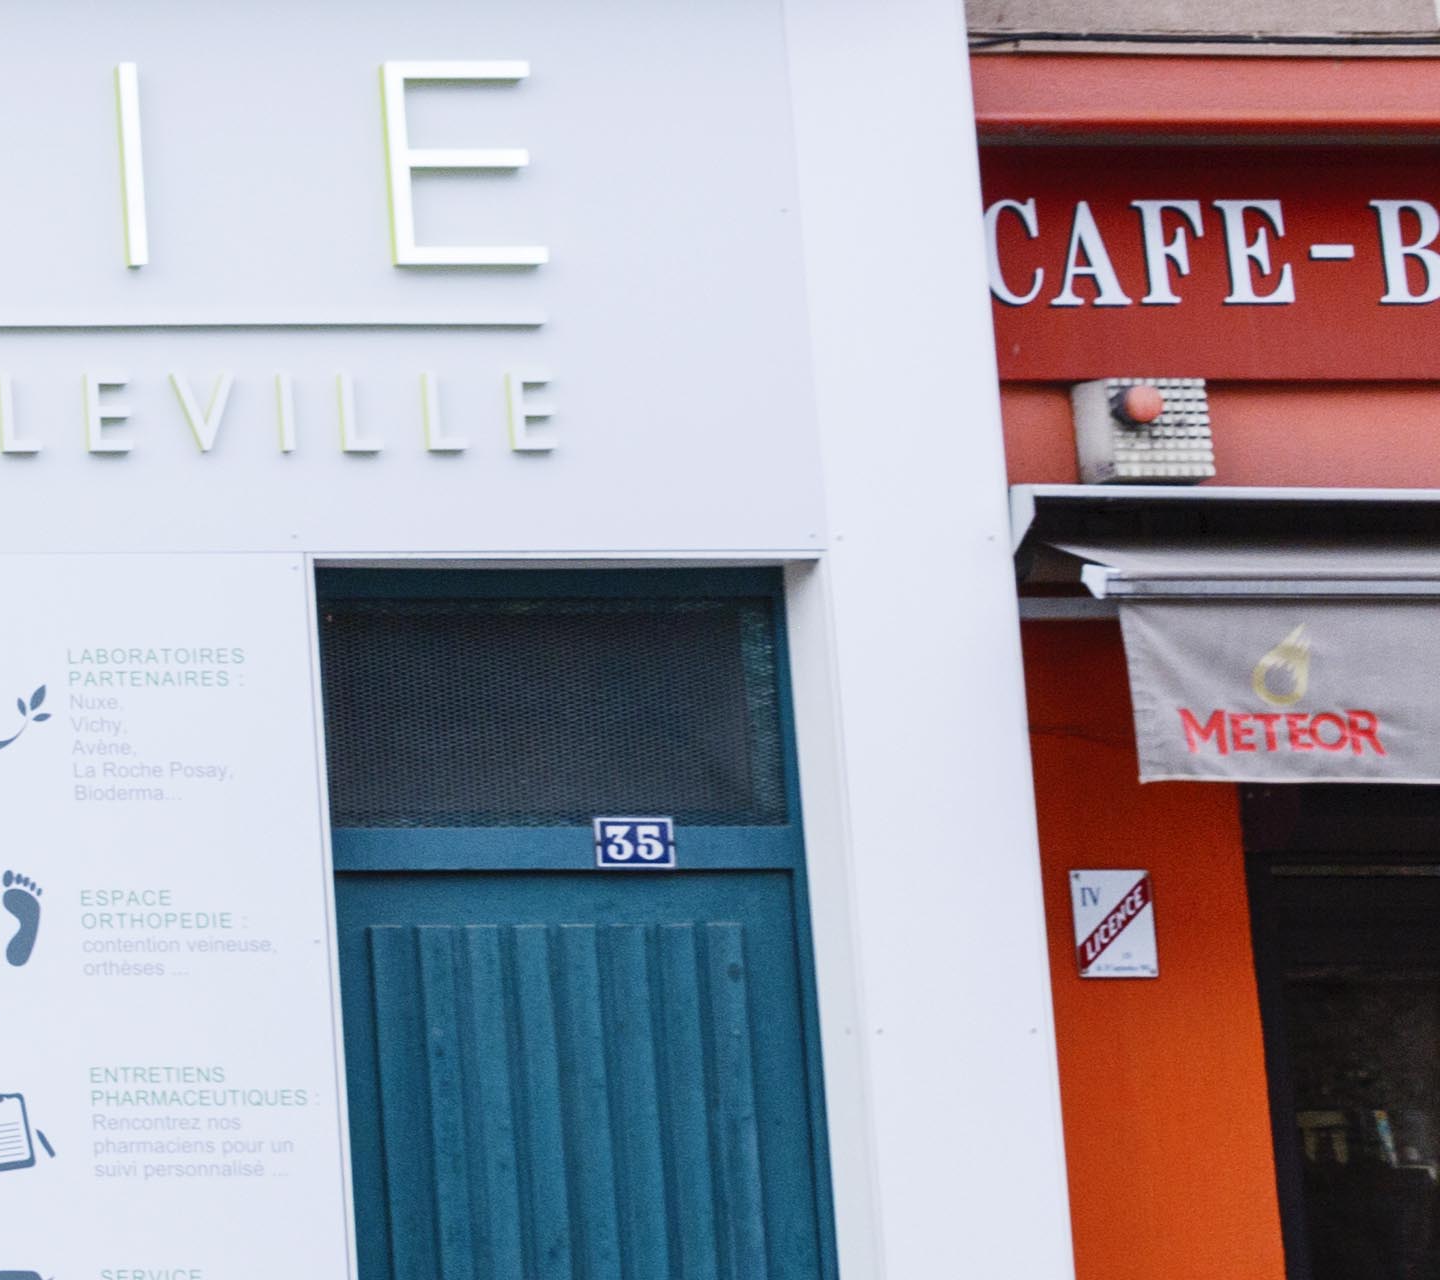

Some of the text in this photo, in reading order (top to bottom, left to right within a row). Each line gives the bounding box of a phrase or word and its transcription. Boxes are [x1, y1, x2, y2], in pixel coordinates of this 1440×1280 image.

[66, 647, 246, 665] LABORATOIRES
[68, 670, 230, 688] PARTENAIRES
[1178, 706, 1388, 758] METEOR
[605, 825, 664, 860] 35
[79, 889, 172, 907] ESPACE
[1081, 886, 1101, 908] IV
[80, 911, 233, 930] ORTHOPEDIE
[1084, 884, 1144, 961] LICENCE
[89, 1066, 226, 1084] ENTRETIENS
